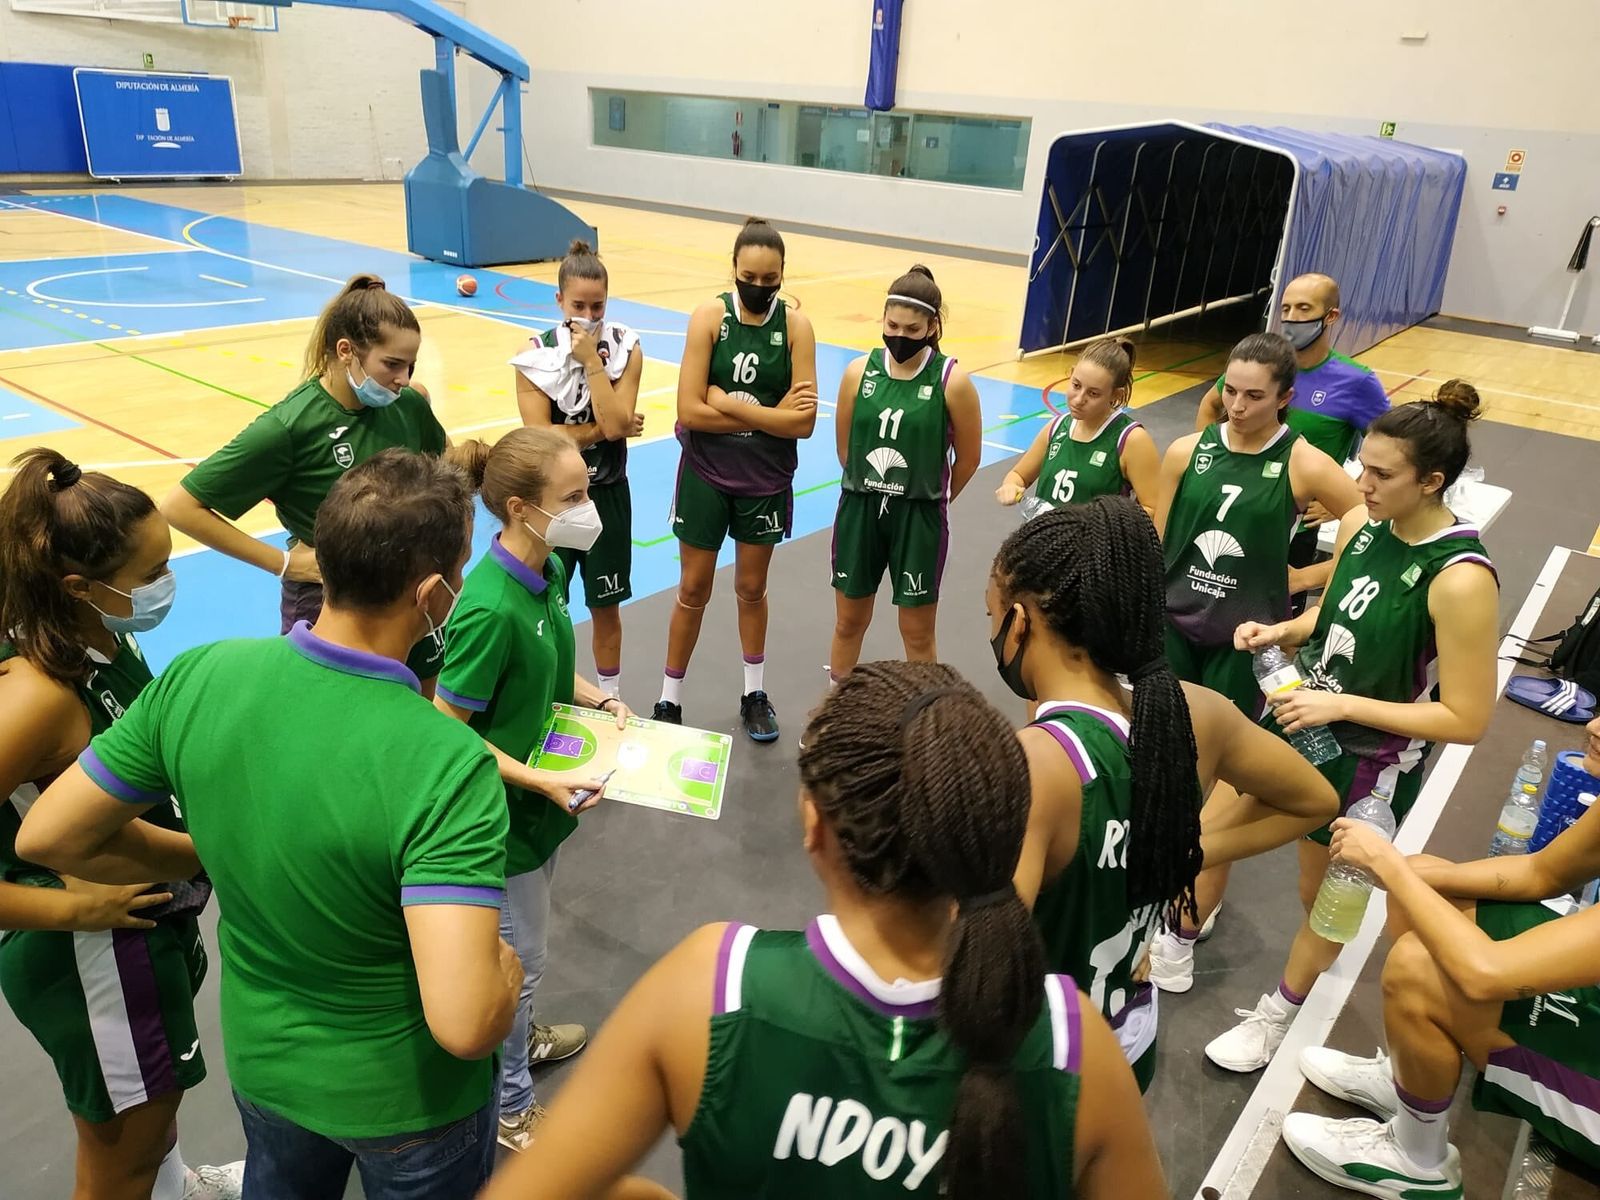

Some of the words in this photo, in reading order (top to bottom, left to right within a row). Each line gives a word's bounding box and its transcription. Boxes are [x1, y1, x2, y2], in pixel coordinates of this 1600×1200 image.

[732, 351, 759, 384] 16
[879, 407, 905, 440] 11
[864, 478, 904, 491] Fundación
[1051, 468, 1079, 503] 15
[1216, 484, 1244, 522] 7
[1189, 565, 1238, 586] Fundación
[1191, 581, 1227, 599] Unicaja
[1338, 574, 1380, 621] 18
[772, 1092, 951, 1195] NDOY
